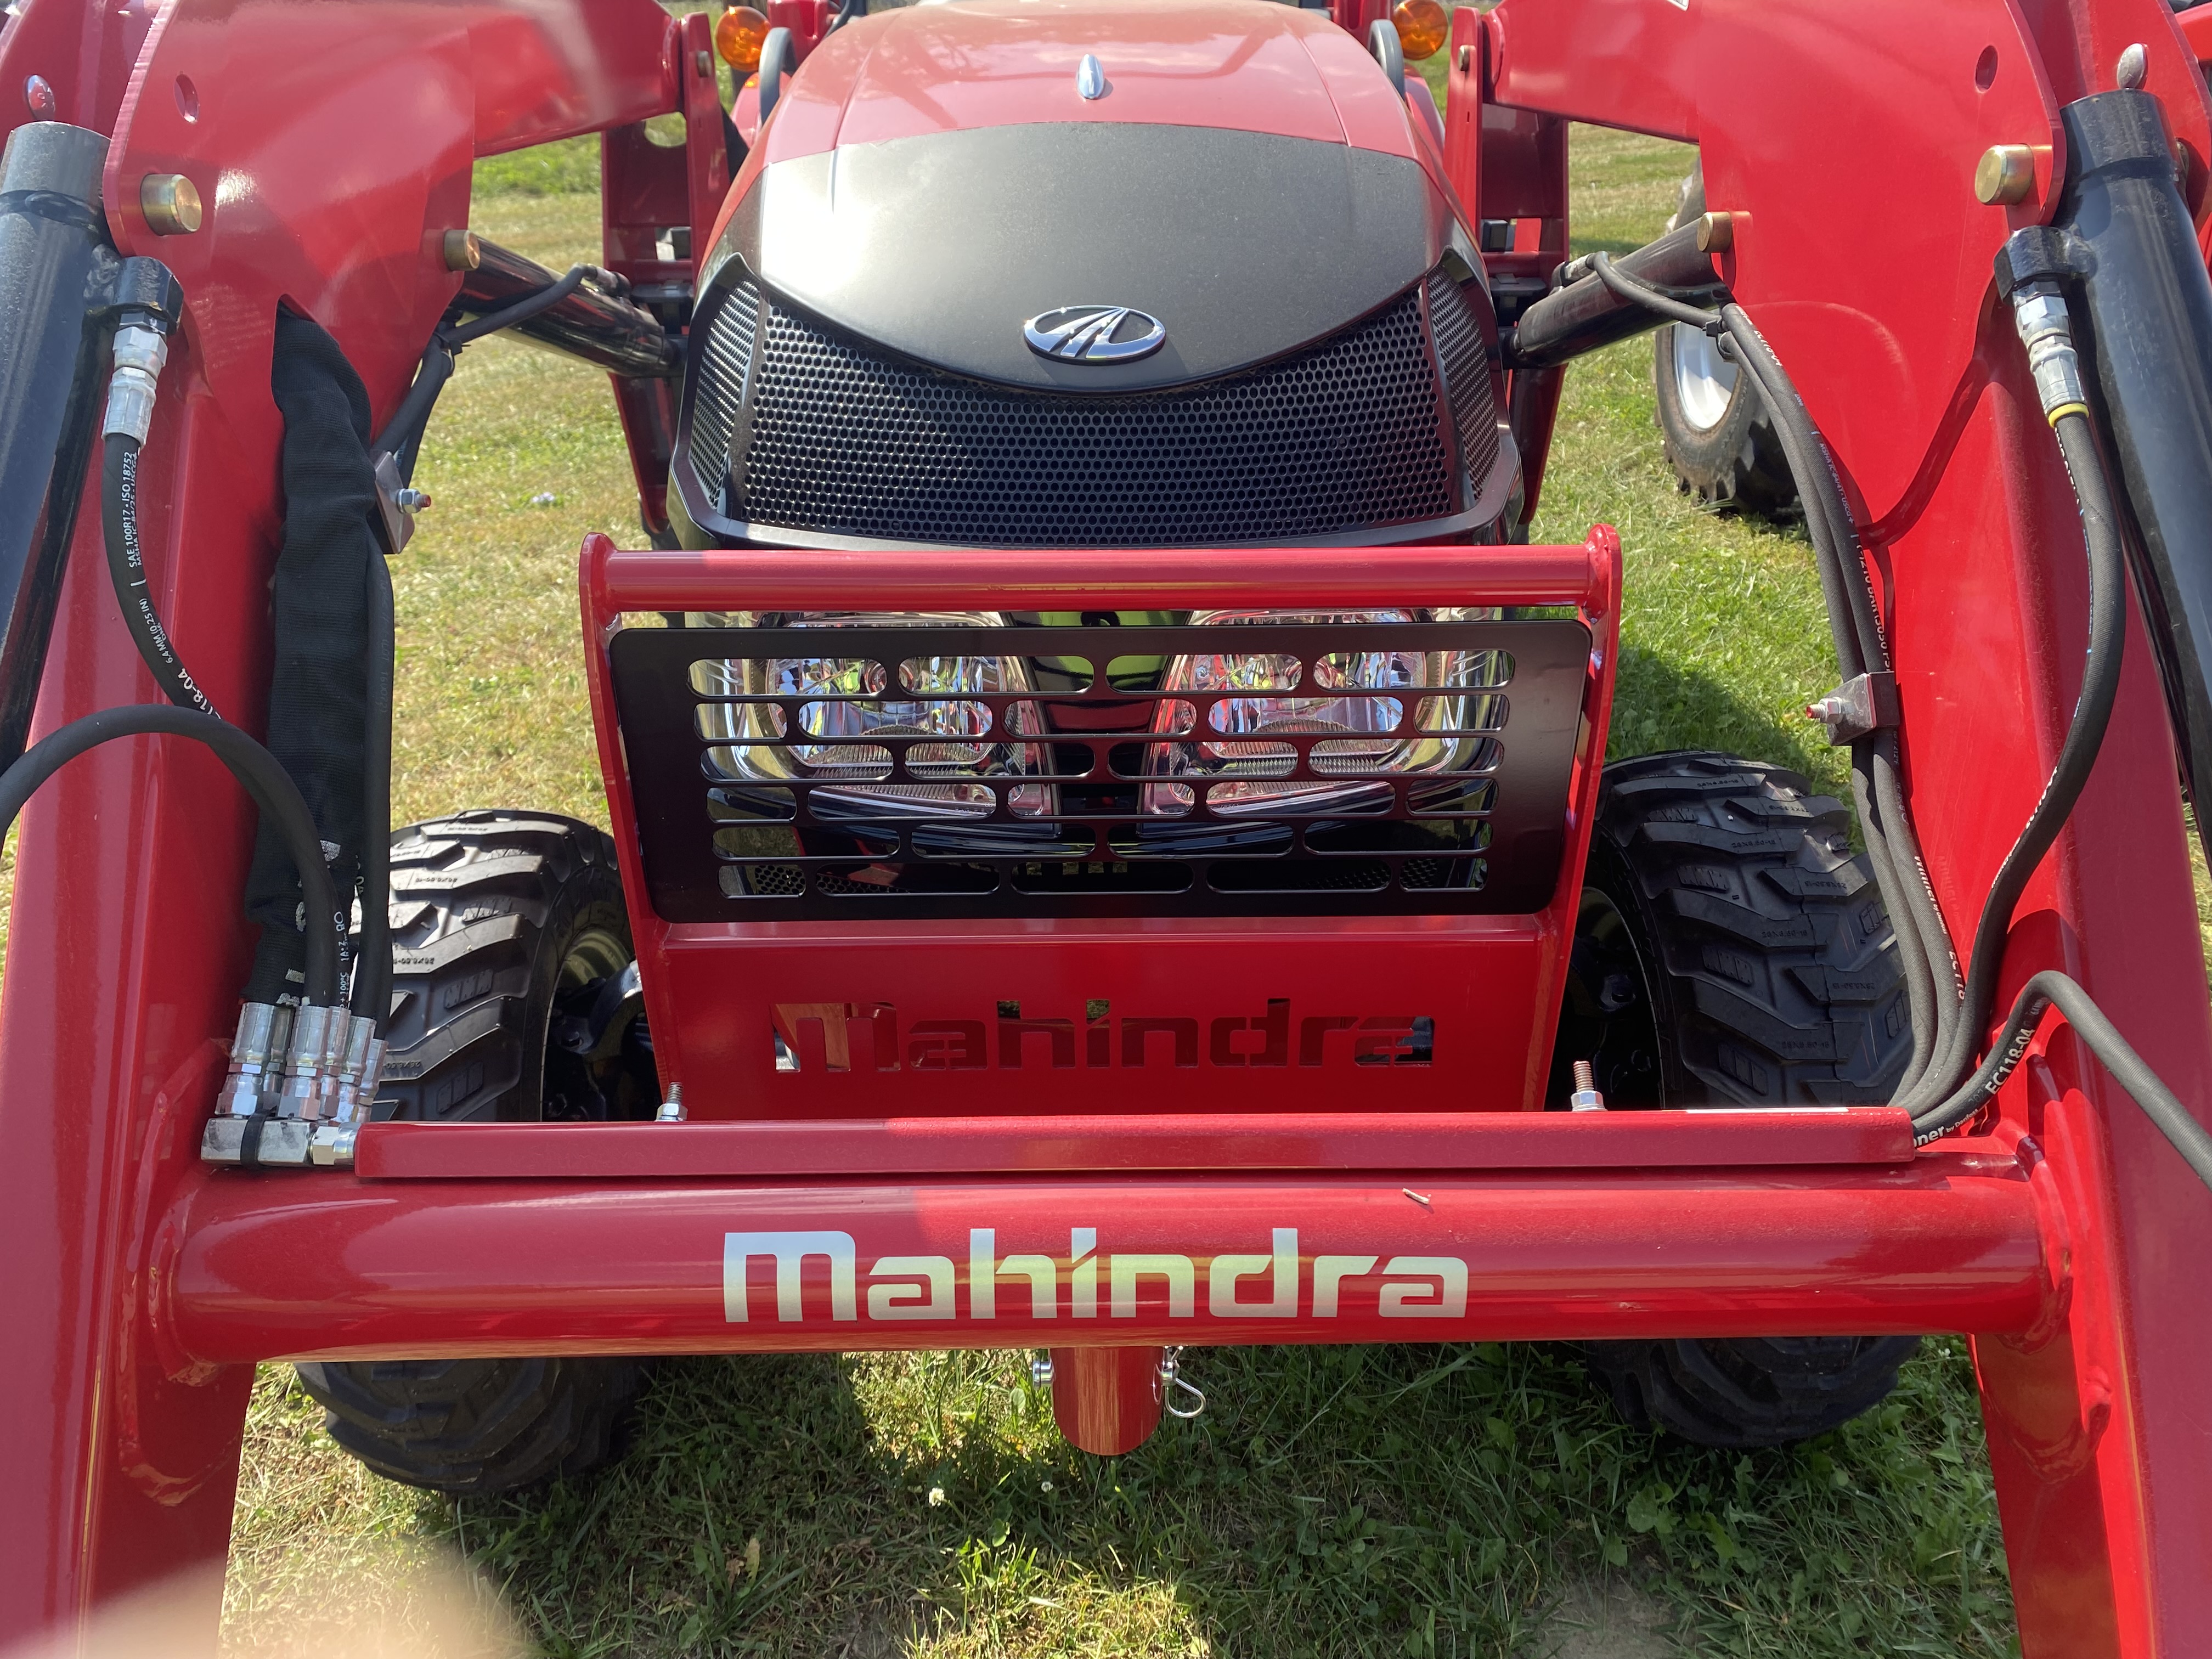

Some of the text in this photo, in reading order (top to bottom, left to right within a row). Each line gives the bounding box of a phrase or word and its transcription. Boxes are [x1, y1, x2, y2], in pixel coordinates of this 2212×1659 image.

[121, 452, 137, 568] SAE 100R17 ISO 18752
[139, 598, 150, 612] IN)
[153, 634, 167, 652] MM
[162, 651, 173, 664] 6.4
[770, 998, 1436, 1072] Mahindra
[1946, 1125, 1955, 1133] by
[1955, 1108, 1978, 1128] Danfoss
[1985, 1028, 2036, 1095] EC118-04
[723, 1227, 1468, 1323] Mahindra
